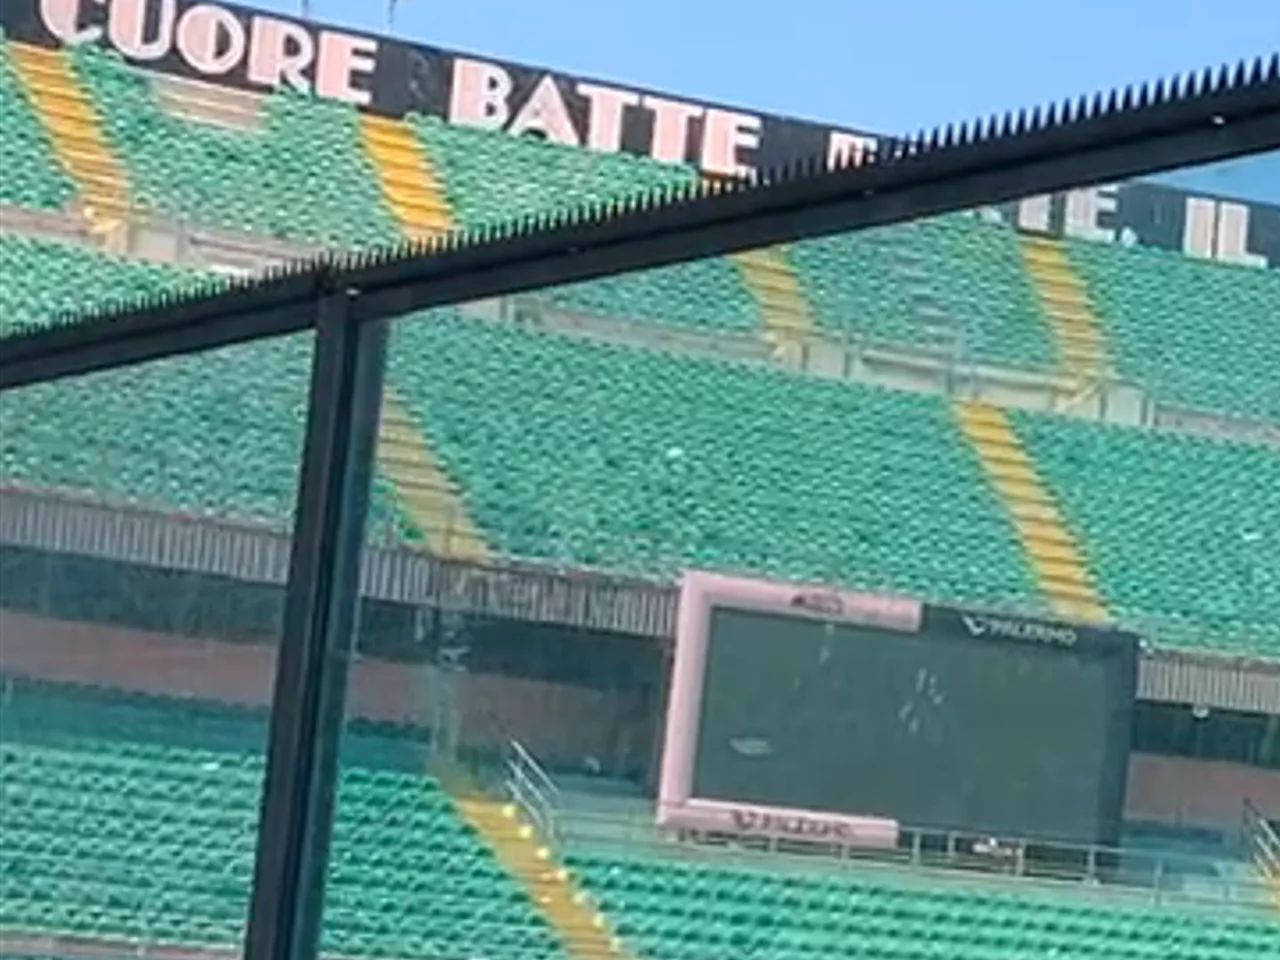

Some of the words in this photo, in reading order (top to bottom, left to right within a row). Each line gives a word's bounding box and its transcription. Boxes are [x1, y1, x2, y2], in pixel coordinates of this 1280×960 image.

[40, 0, 377, 103] CUORE
[449, 57, 763, 177] BATTE
[1184, 197, 1268, 269] IL
